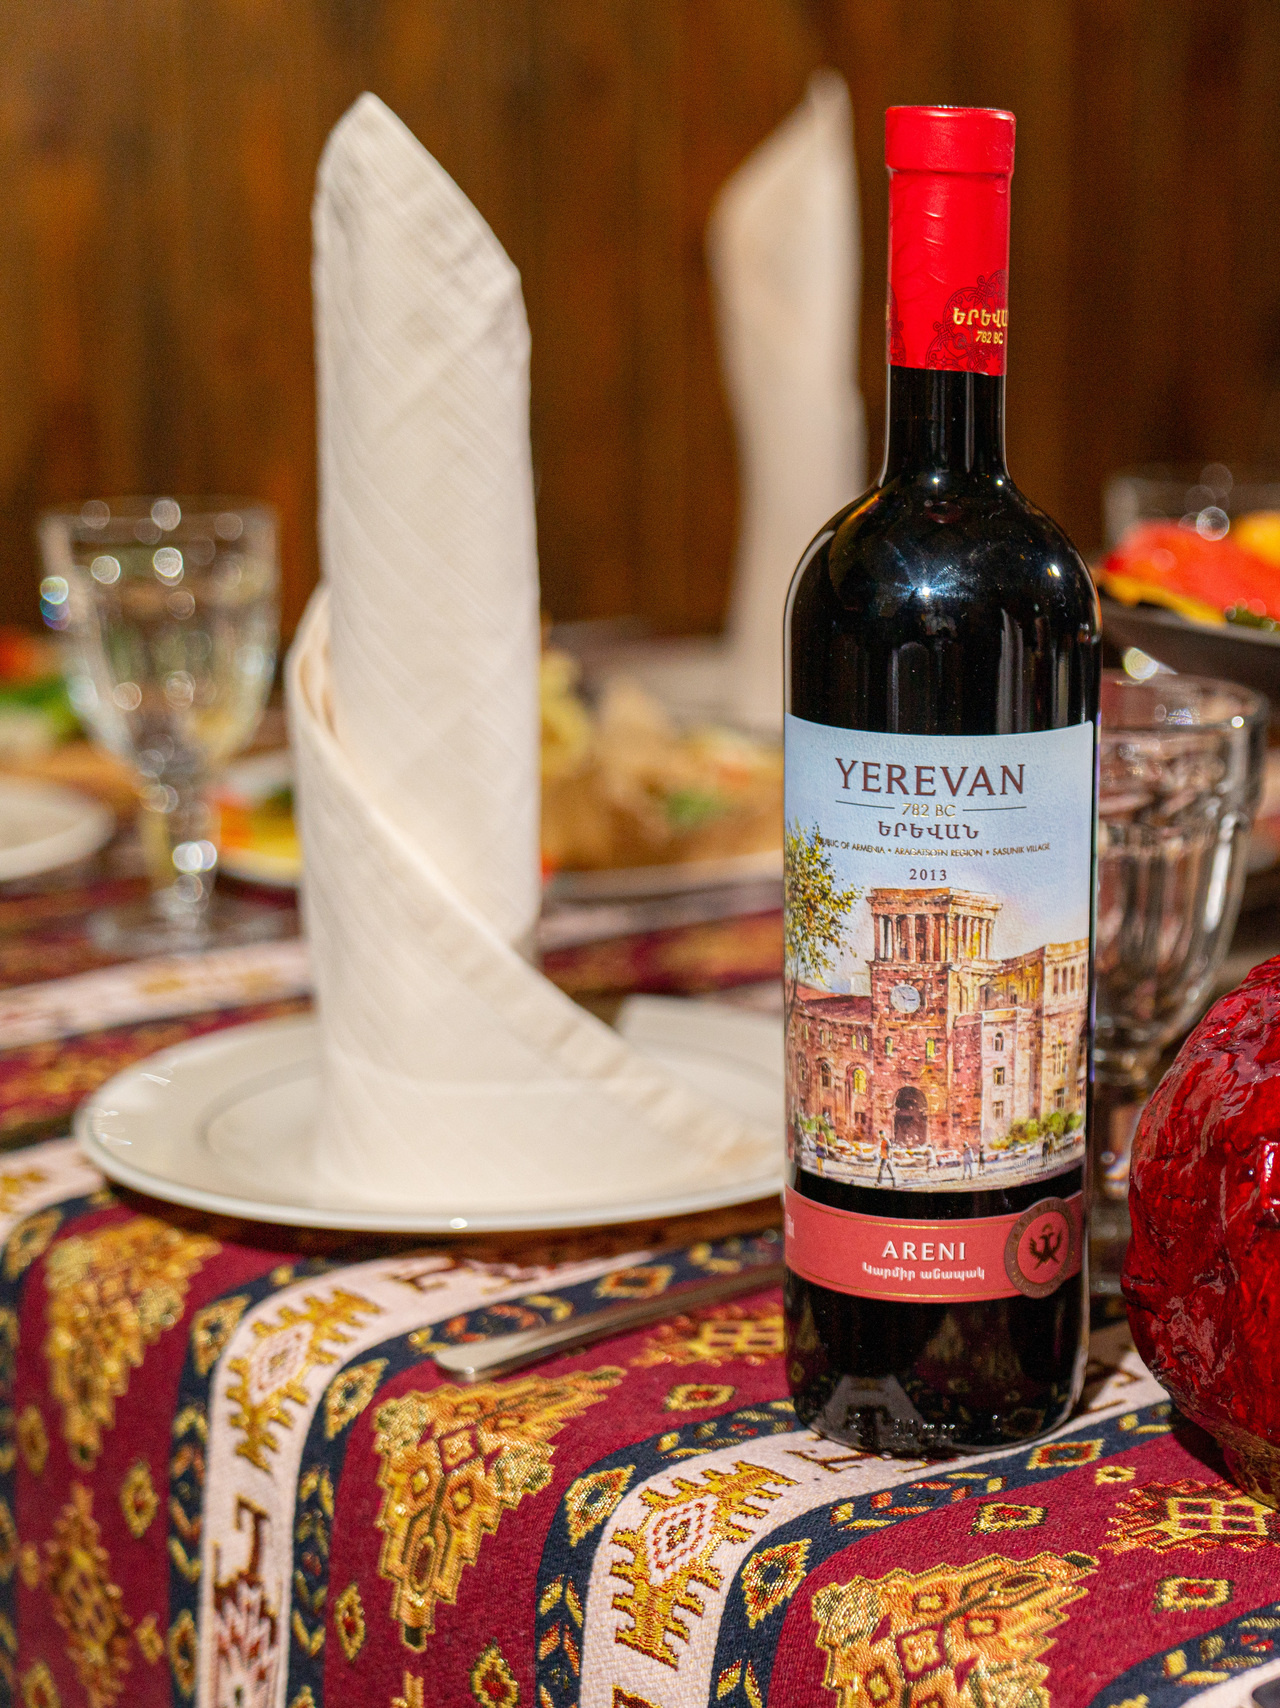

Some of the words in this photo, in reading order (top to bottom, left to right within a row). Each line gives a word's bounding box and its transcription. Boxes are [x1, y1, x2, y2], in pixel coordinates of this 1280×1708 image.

[976, 330, 992, 344] 782
[993, 332, 1004, 345] BC
[835, 757, 1026, 797] YEREVAN
[901, 803, 930, 818] 782
[935, 804, 957, 818] BC
[877, 820, 980, 840] ԵՐԵՎԱՆ
[840, 841, 850, 850] OF
[851, 844, 886, 855] ARMENIA
[950, 848, 984, 858] REGION
[1026, 841, 1051, 853] VILLAGE
[909, 868, 948, 881] 2013
[881, 1240, 967, 1261] ARENI
[862, 1261, 916, 1282] Կարմիր
